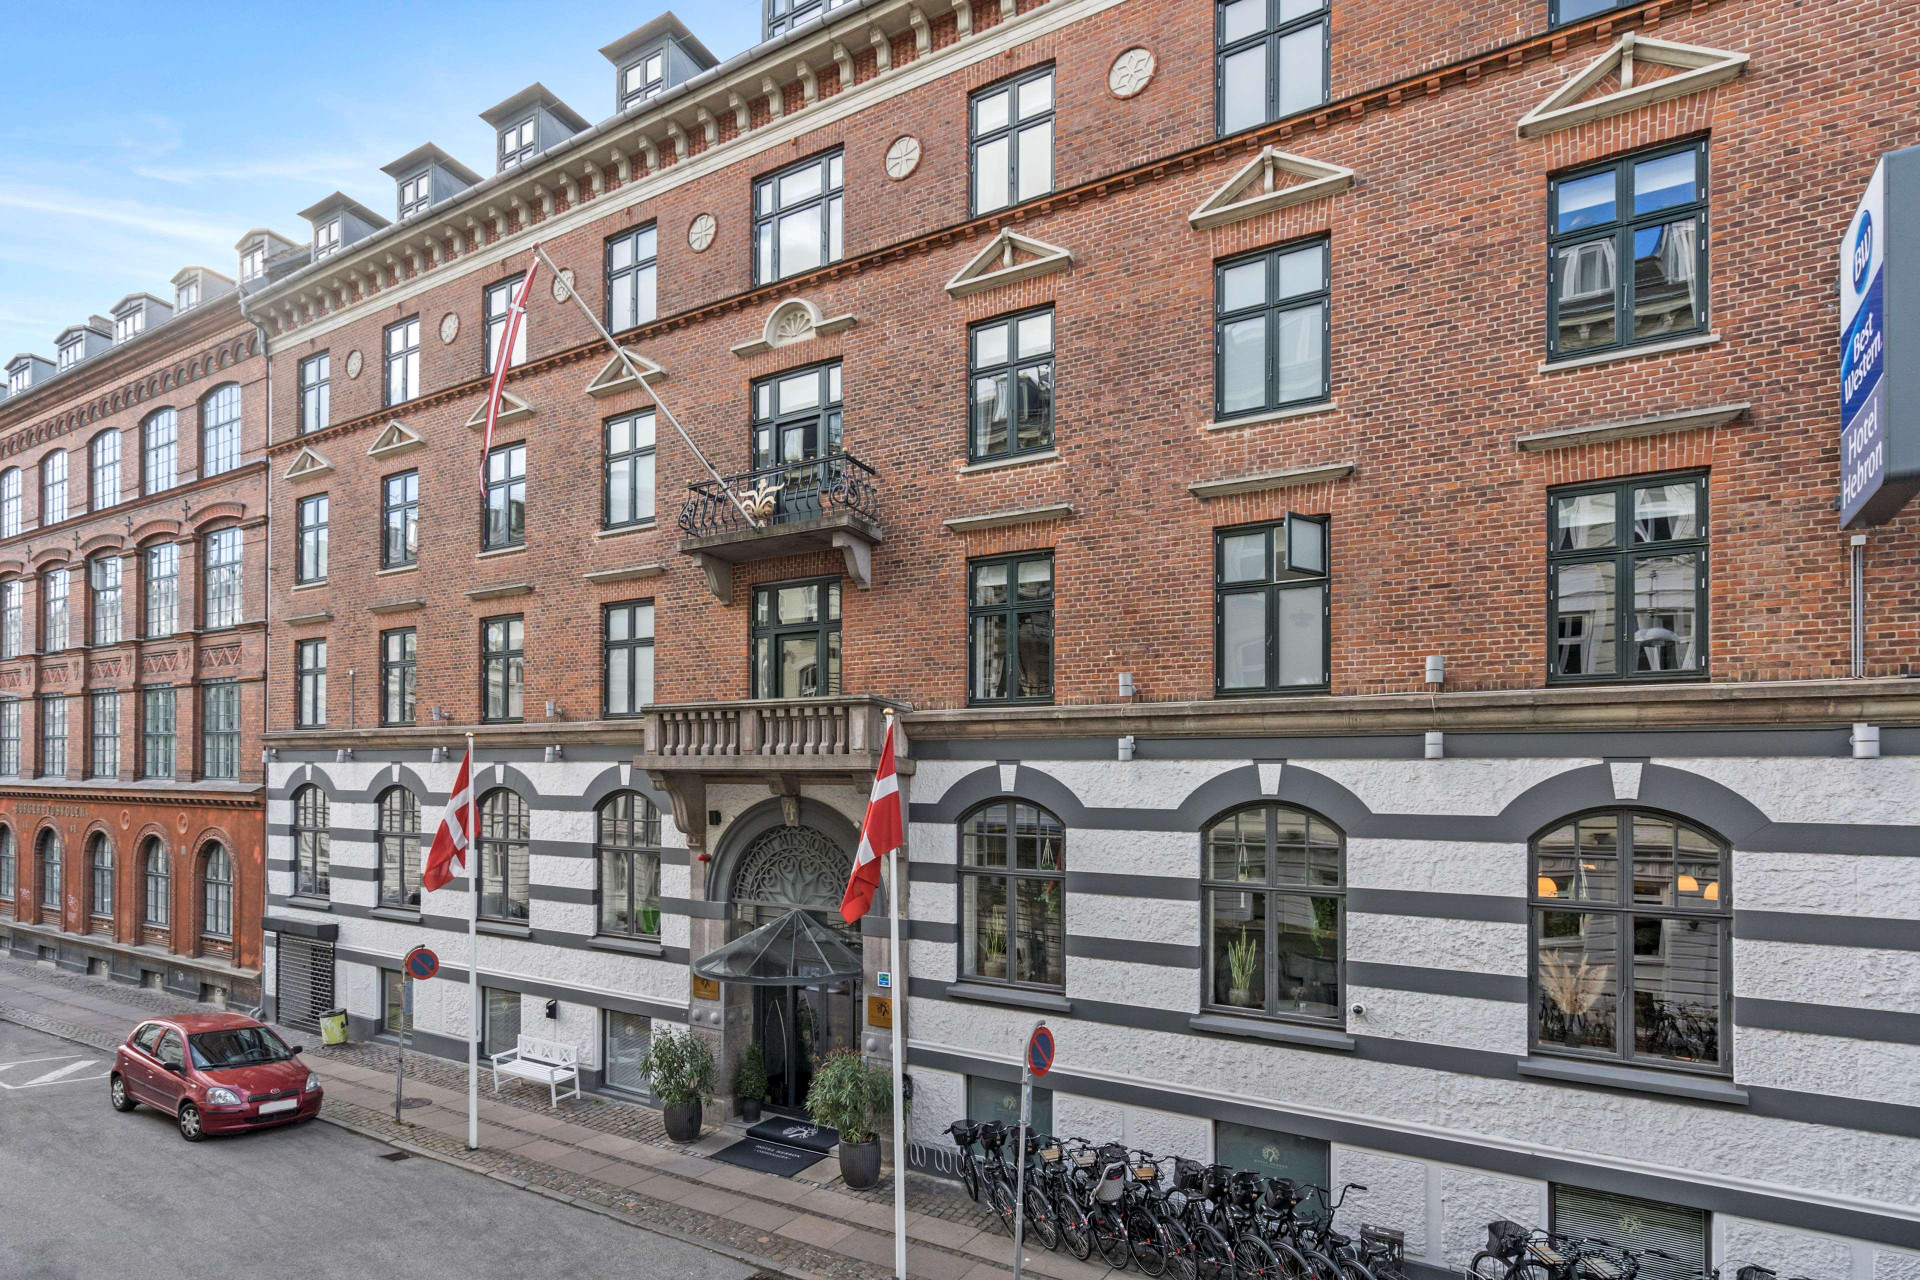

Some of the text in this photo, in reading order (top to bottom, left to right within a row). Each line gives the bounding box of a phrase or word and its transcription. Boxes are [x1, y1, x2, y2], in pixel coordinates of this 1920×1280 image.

[1855, 225, 1871, 282] BW
[1853, 312, 1873, 363] Best
[1848, 397, 1877, 465] Hotel
[1843, 441, 1882, 509] Hebron
